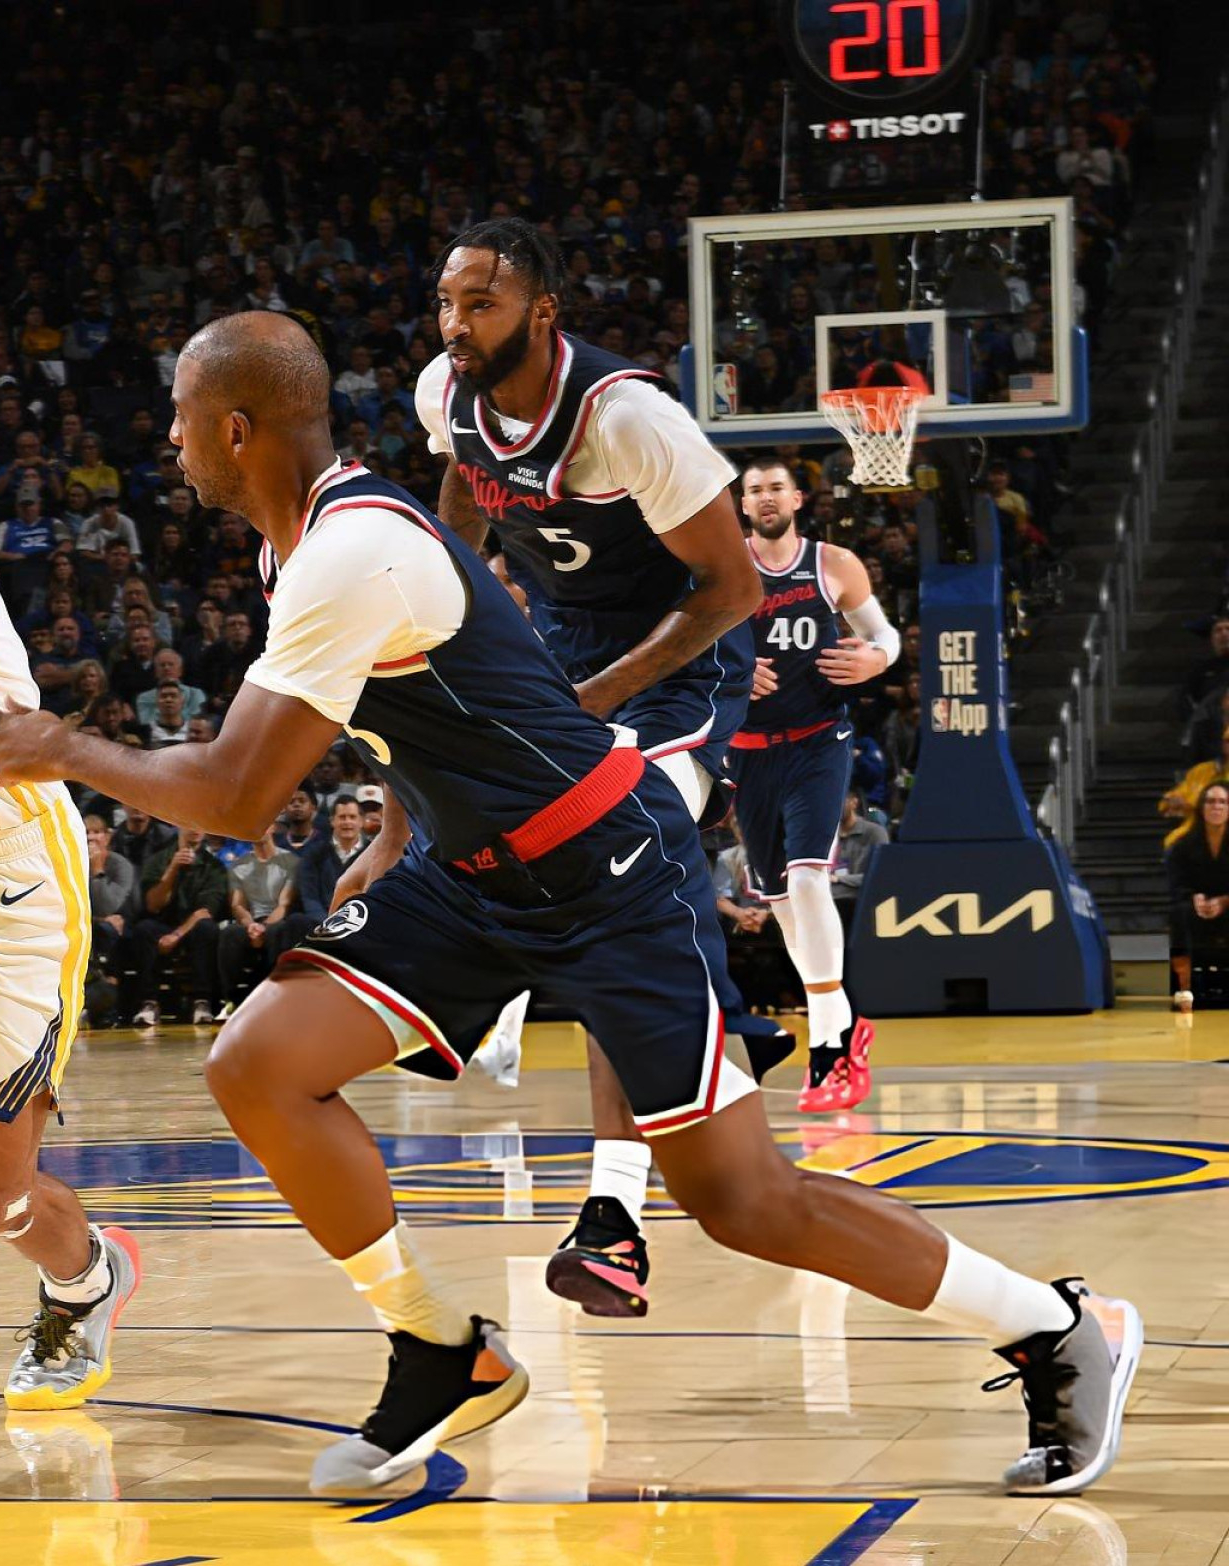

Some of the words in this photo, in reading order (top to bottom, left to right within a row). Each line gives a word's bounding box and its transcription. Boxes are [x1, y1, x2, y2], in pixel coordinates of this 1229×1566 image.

[828, 0, 940, 81] 20
[850, 112, 966, 139] TISSOT
[508, 473, 544, 490] RWANDA
[517, 466, 538, 479] VISIT
[536, 527, 592, 572] 5
[766, 616, 817, 651] 40
[938, 630, 976, 662] GET
[938, 664, 978, 695] THE
[950, 698, 988, 736] App
